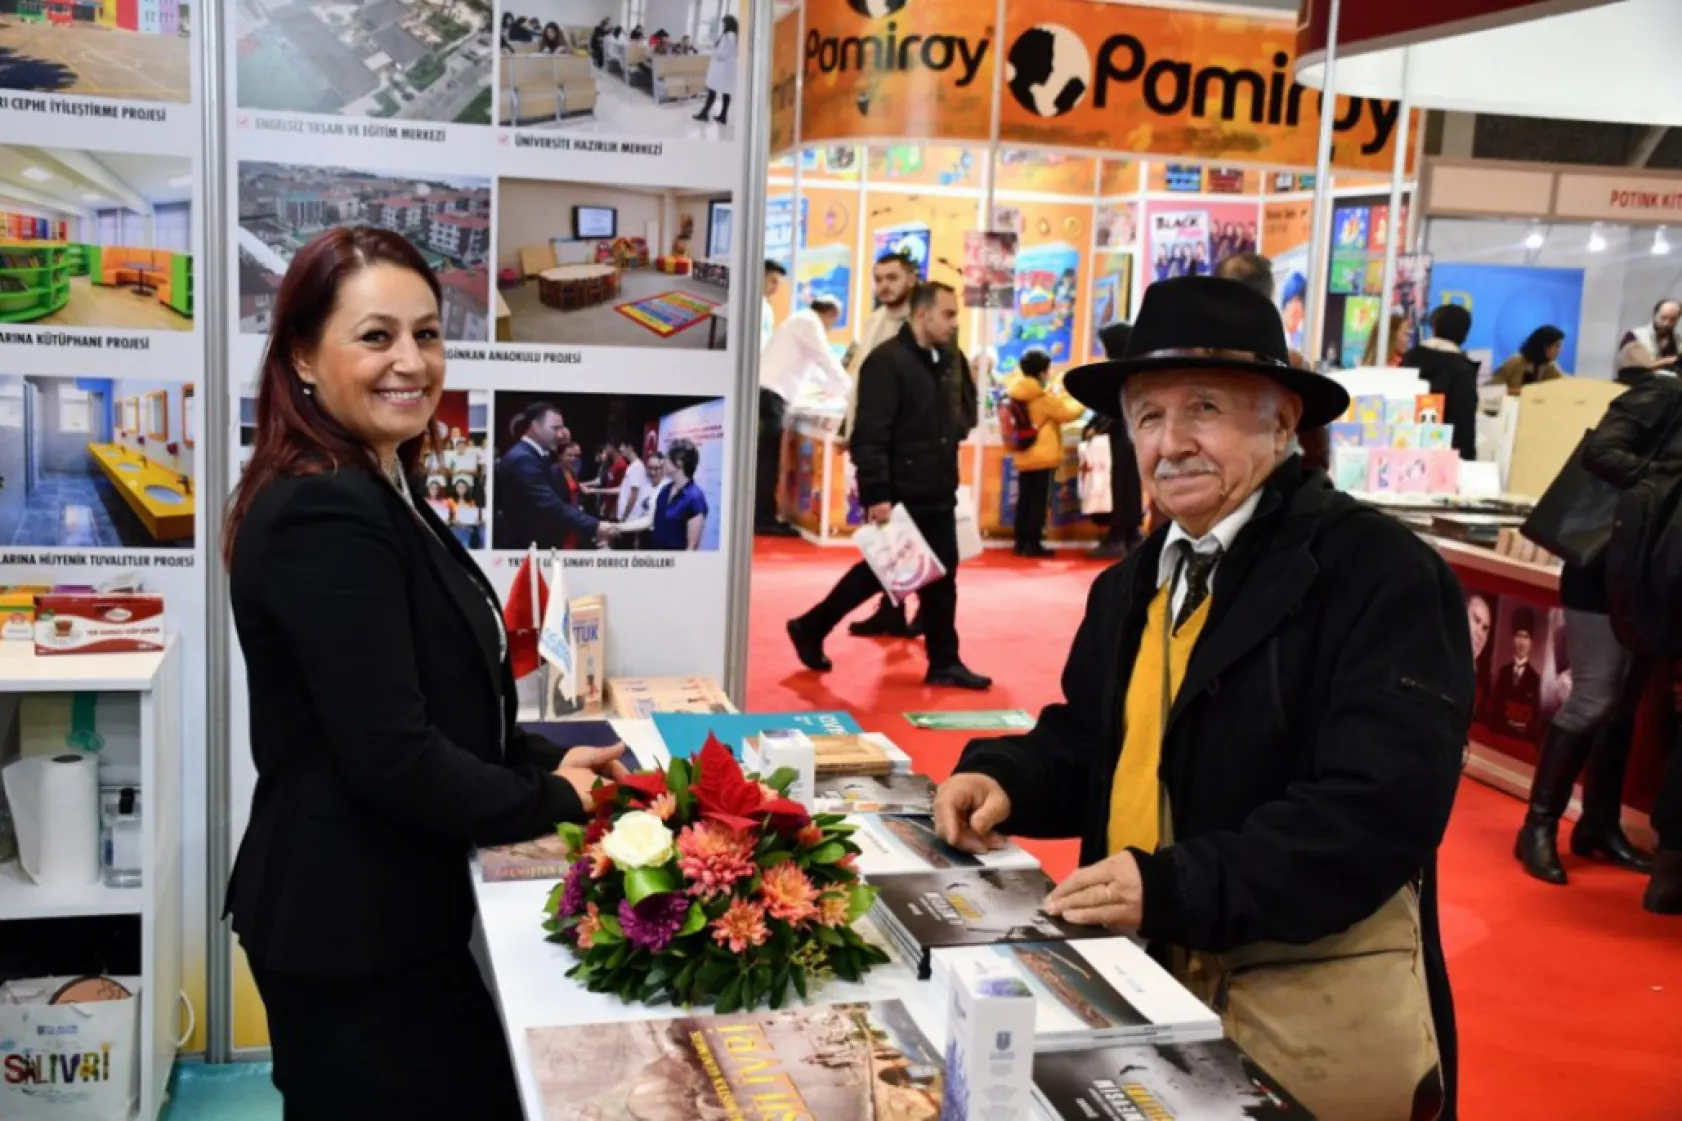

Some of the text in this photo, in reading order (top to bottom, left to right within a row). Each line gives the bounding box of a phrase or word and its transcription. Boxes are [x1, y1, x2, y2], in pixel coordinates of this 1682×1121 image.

[11, 98, 46, 113] CEPHE
[121, 106, 167, 121] PROJESİ
[347, 124, 359, 137] VE
[362, 123, 398, 139] EĞİTİM
[402, 127, 446, 142] MERKEZİ
[515, 132, 662, 156] ÜNİVERSİTE HAZIRLIK MERKEZİ
[36, 331, 103, 348] KÜTÜPHANE
[106, 336, 150, 350] PROJESİ
[488, 350, 541, 363] ANAOKULU
[543, 352, 582, 364] PROJESİ
[90, 553, 150, 567] TUVALETLER
[153, 553, 195, 568] PROJESİ
[563, 556, 594, 568] SINAVI
[597, 556, 629, 568] DERECE
[631, 555, 676, 568] ÖDÜLLERİ
[573, 624, 599, 645] TUK
